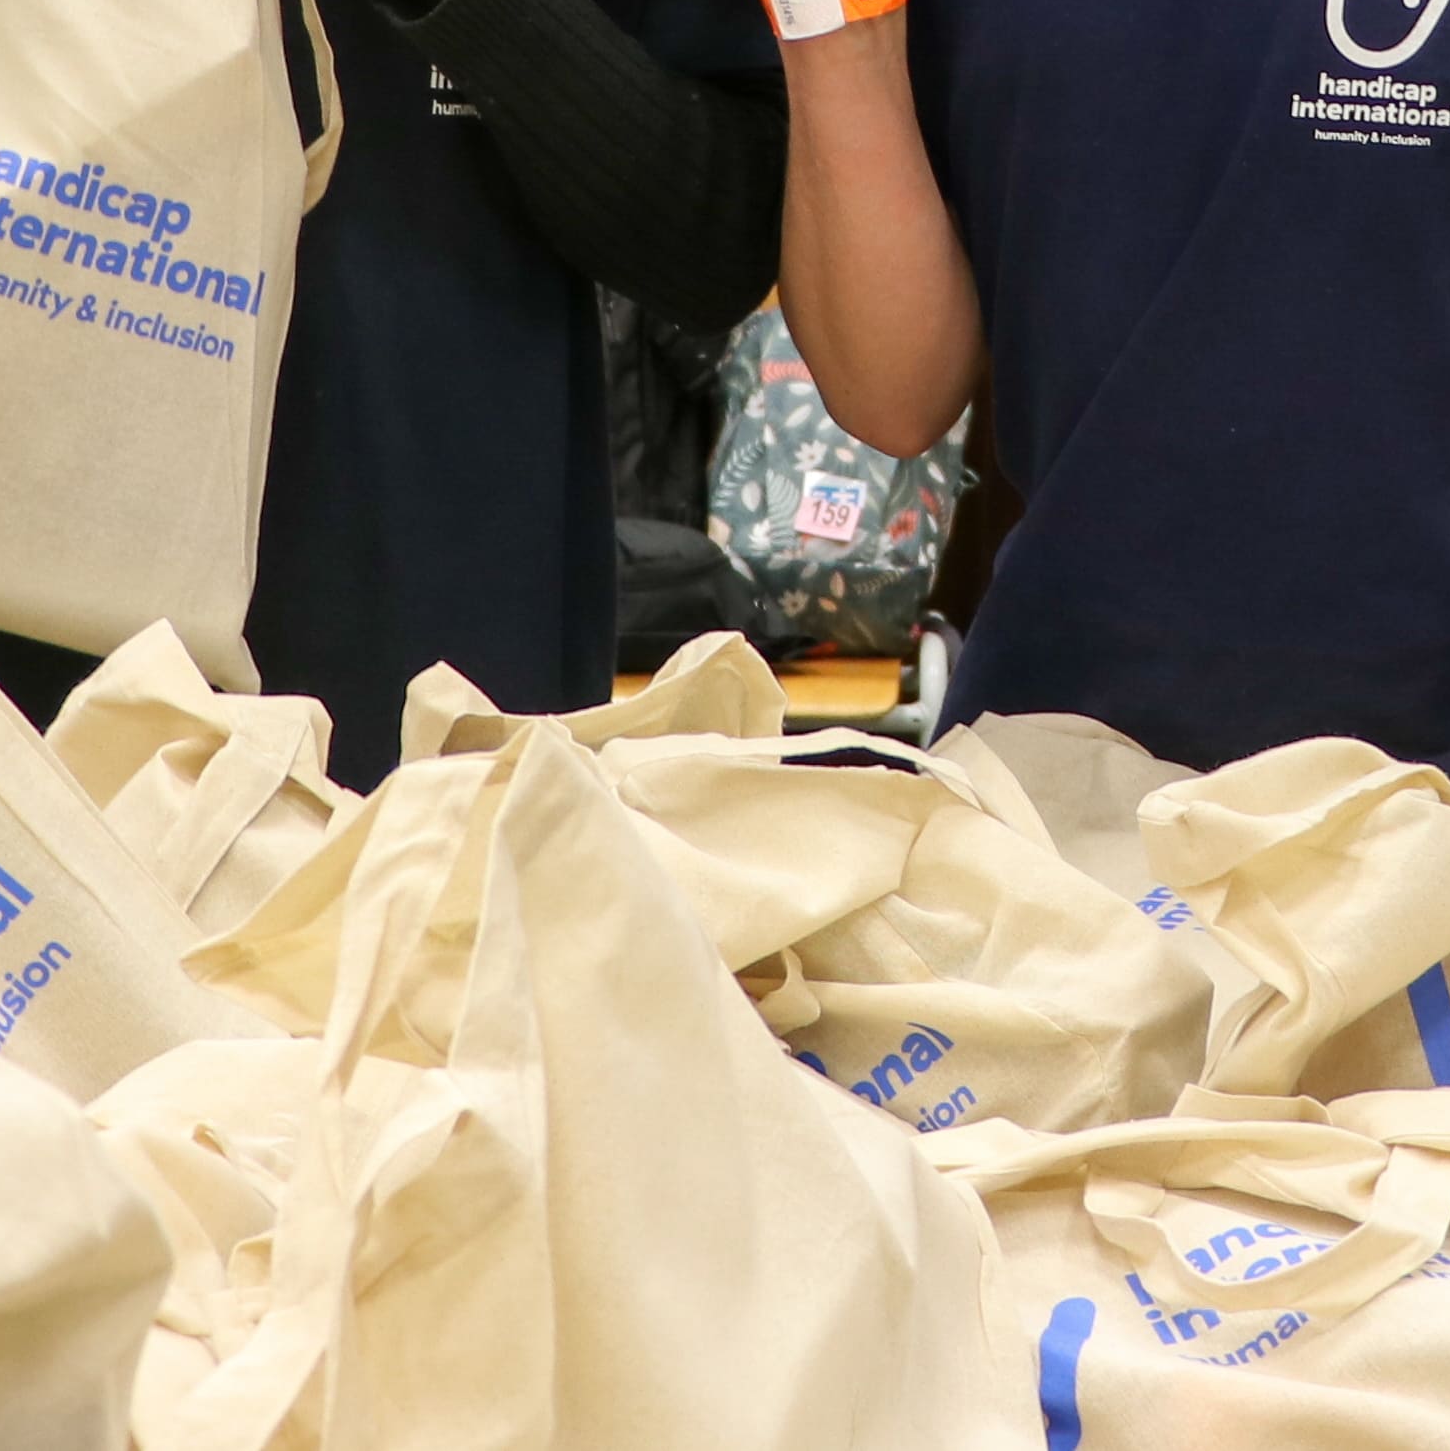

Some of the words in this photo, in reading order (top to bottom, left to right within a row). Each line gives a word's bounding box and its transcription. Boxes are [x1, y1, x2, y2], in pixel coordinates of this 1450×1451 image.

[1318, 71, 1437, 107] handicap
[1314, 128, 1370, 145] humanity
[1370, 131, 1380, 144] &
[1381, 132, 1431, 147] inclusion
[75, 294, 98, 323] &
[104, 301, 235, 362] inclusion
[811, 498, 851, 527] 159
